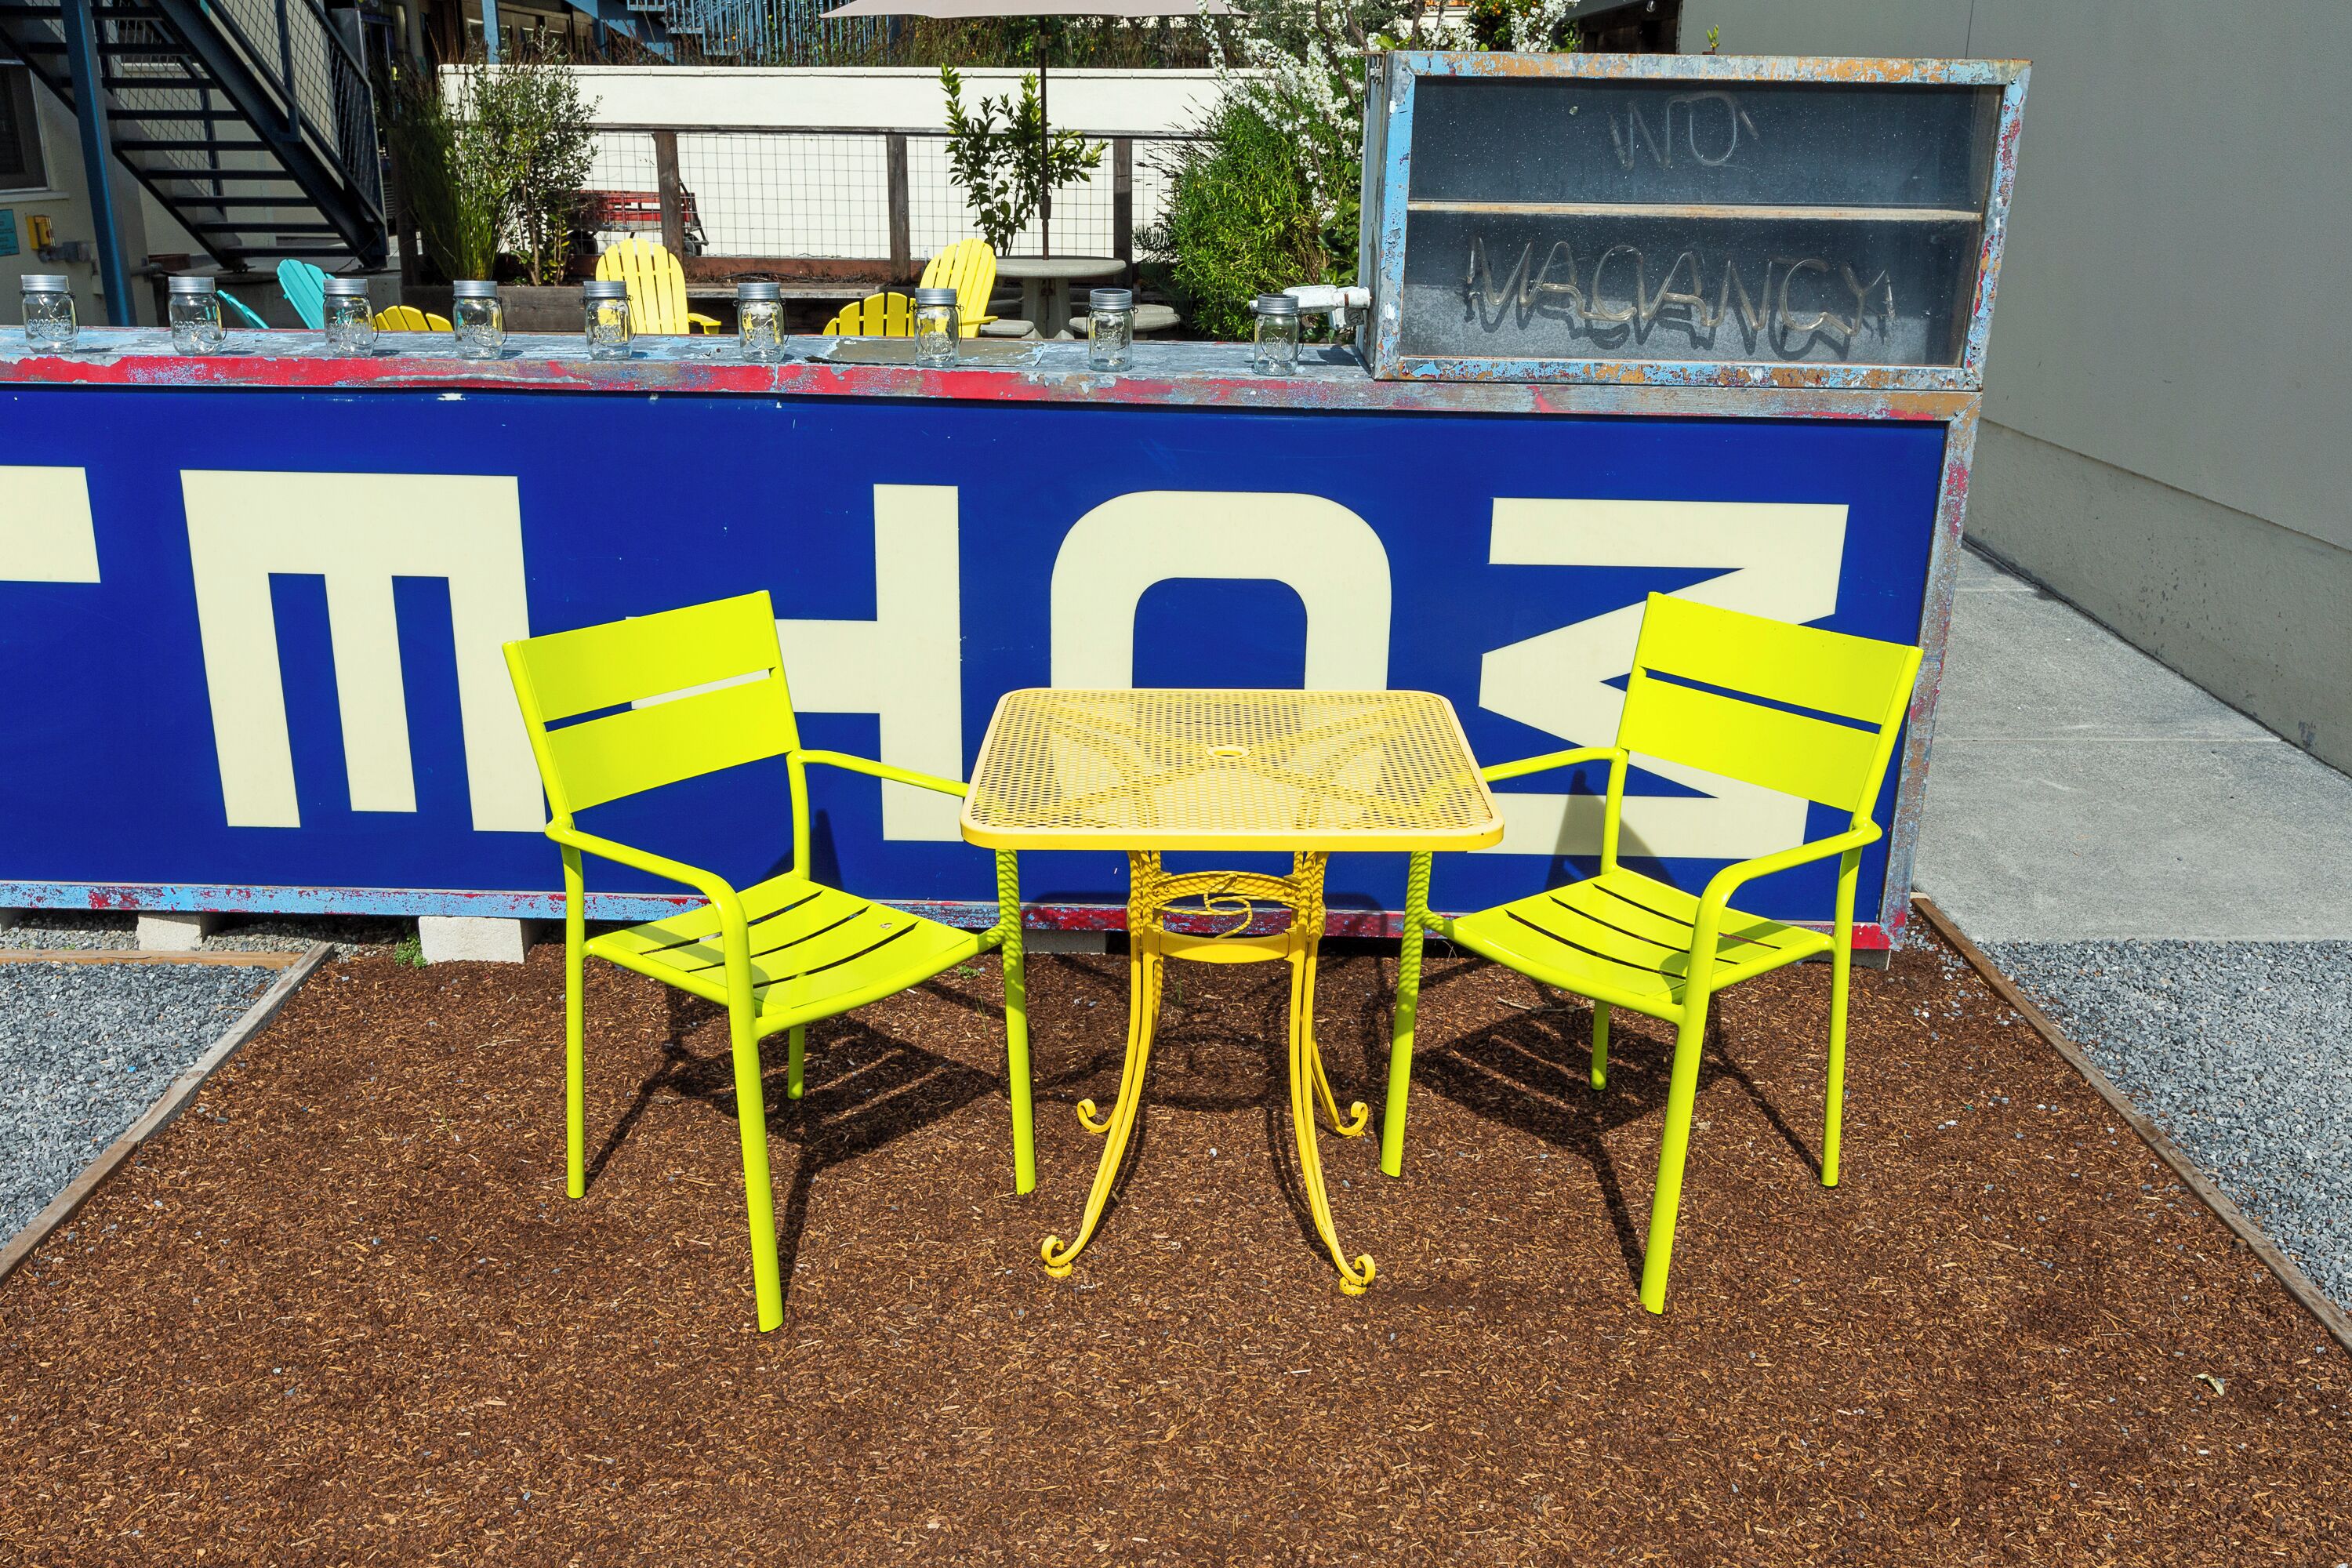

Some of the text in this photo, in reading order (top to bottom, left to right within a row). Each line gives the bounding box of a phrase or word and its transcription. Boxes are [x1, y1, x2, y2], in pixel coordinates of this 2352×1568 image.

[1610, 90, 1759, 171] NO
[1466, 236, 1896, 337] VACANCY
[0, 465, 1849, 859] MOTE
